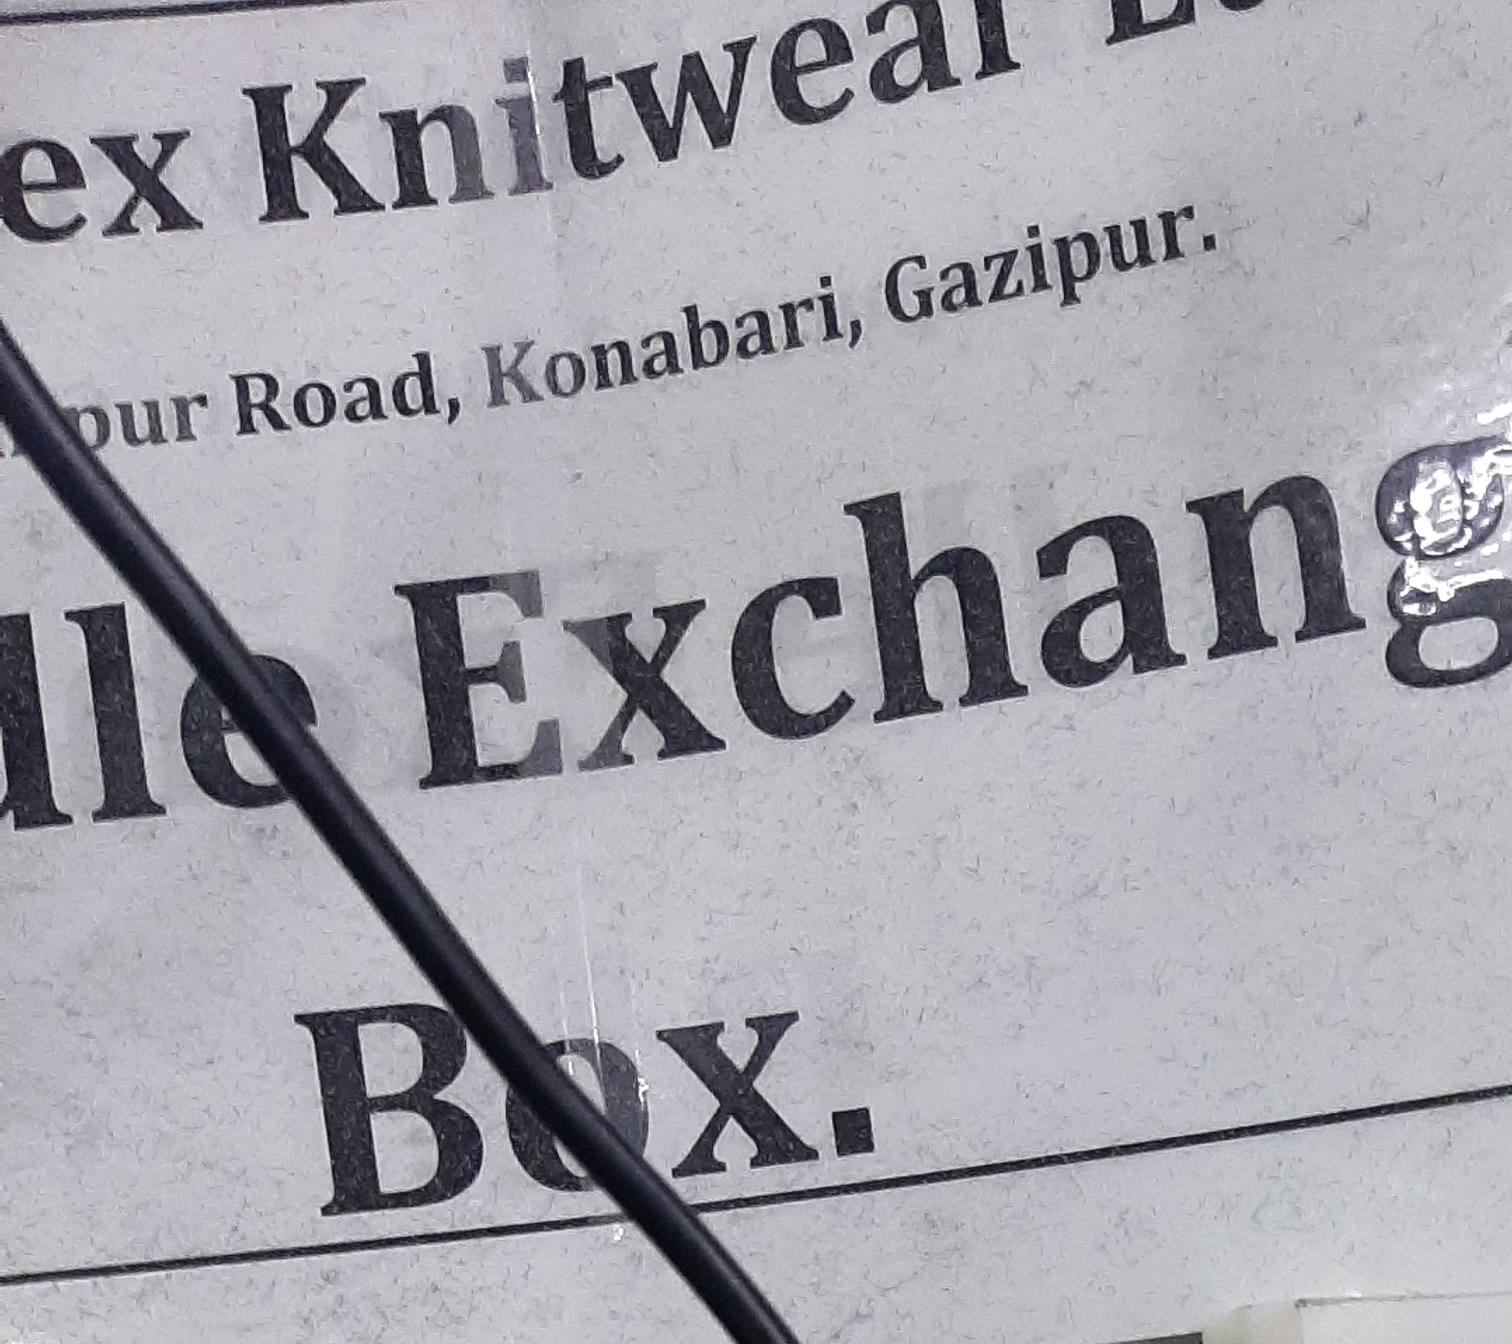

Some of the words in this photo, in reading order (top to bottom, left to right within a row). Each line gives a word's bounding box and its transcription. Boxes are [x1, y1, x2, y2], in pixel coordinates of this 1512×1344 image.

[0, 128, 204, 243] ex
[0, 392, 209, 458] pur
[229, 351, 462, 437] Road,
[481, 273, 864, 408] Konabari,
[884, 204, 1218, 323] Gazipur.
[293, 1002, 876, 1217] Box.
